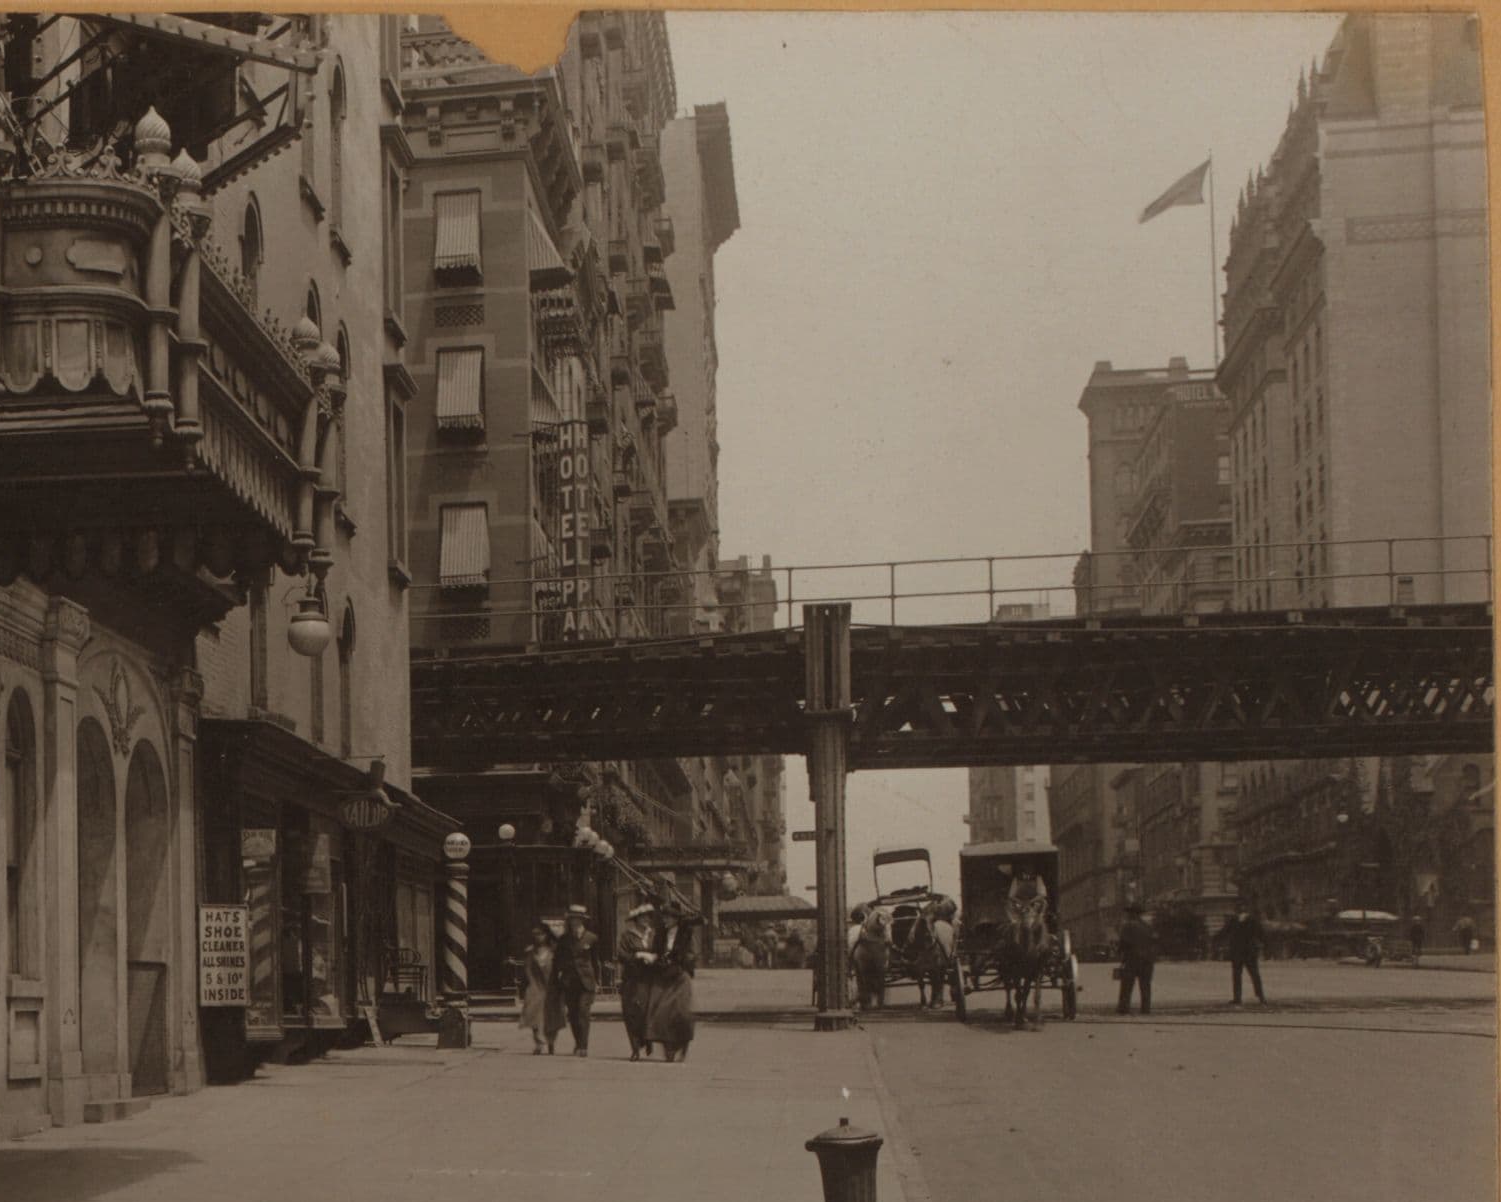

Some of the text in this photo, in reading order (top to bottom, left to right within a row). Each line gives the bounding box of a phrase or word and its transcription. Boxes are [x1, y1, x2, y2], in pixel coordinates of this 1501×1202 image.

[560, 424, 575, 567] HOTEL
[574, 423, 590, 567] HOTEL
[205, 911, 241, 923] HATS
[204, 926, 242, 938] SHOE
[202, 941, 245, 953] CLEANER
[203, 988, 245, 1001] INSIDE
